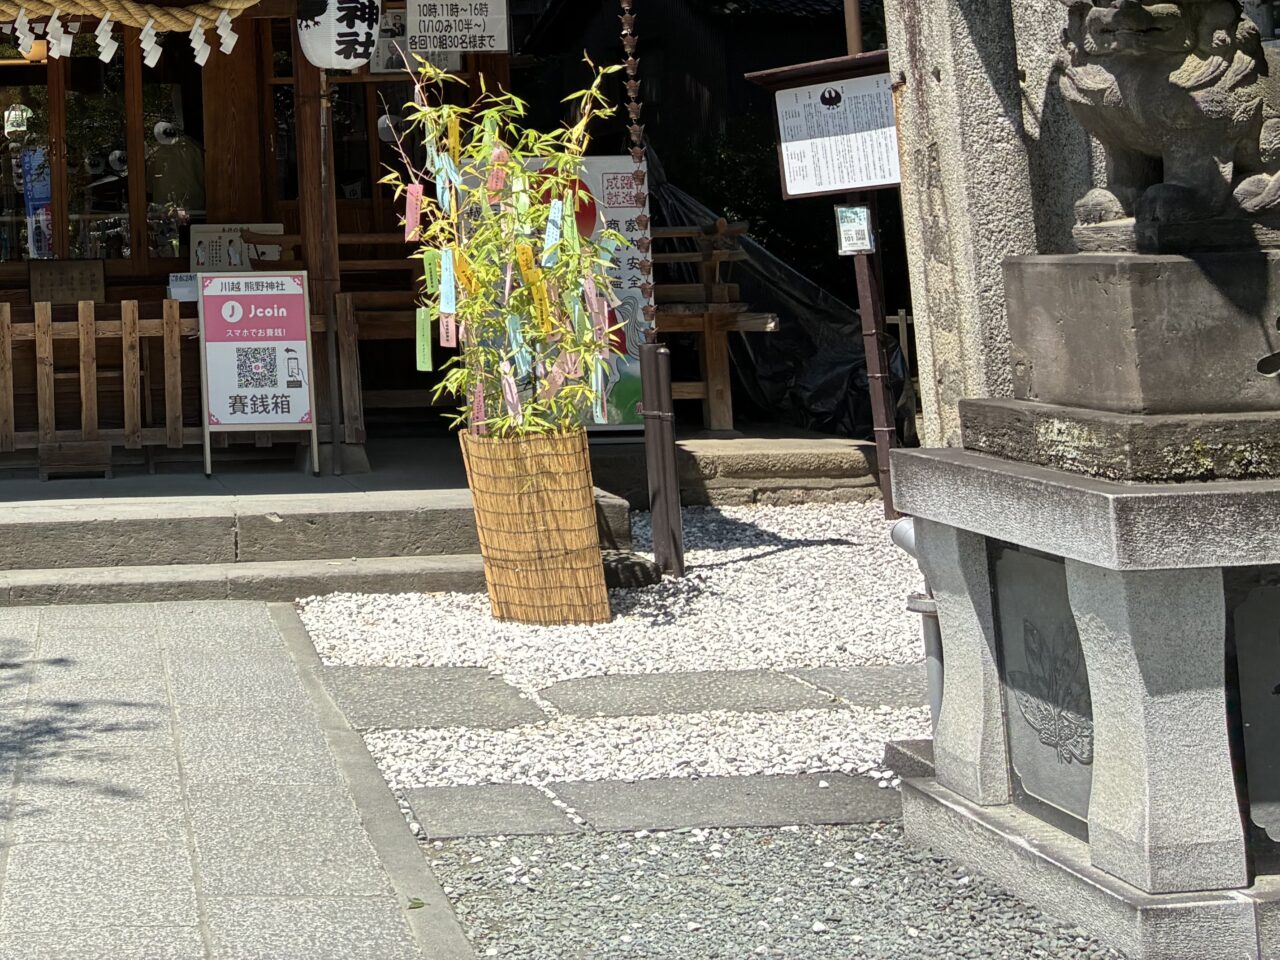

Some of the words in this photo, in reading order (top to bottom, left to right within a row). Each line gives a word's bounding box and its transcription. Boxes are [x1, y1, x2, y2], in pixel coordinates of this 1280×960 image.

[409, 35, 496, 50] 各回10組30名様まで
[221, 281, 241, 292] 川越
[244, 281, 286, 292] 熊野神社
[249, 304, 287, 318] Jcoin
[229, 393, 291, 415] 賽銭箱
